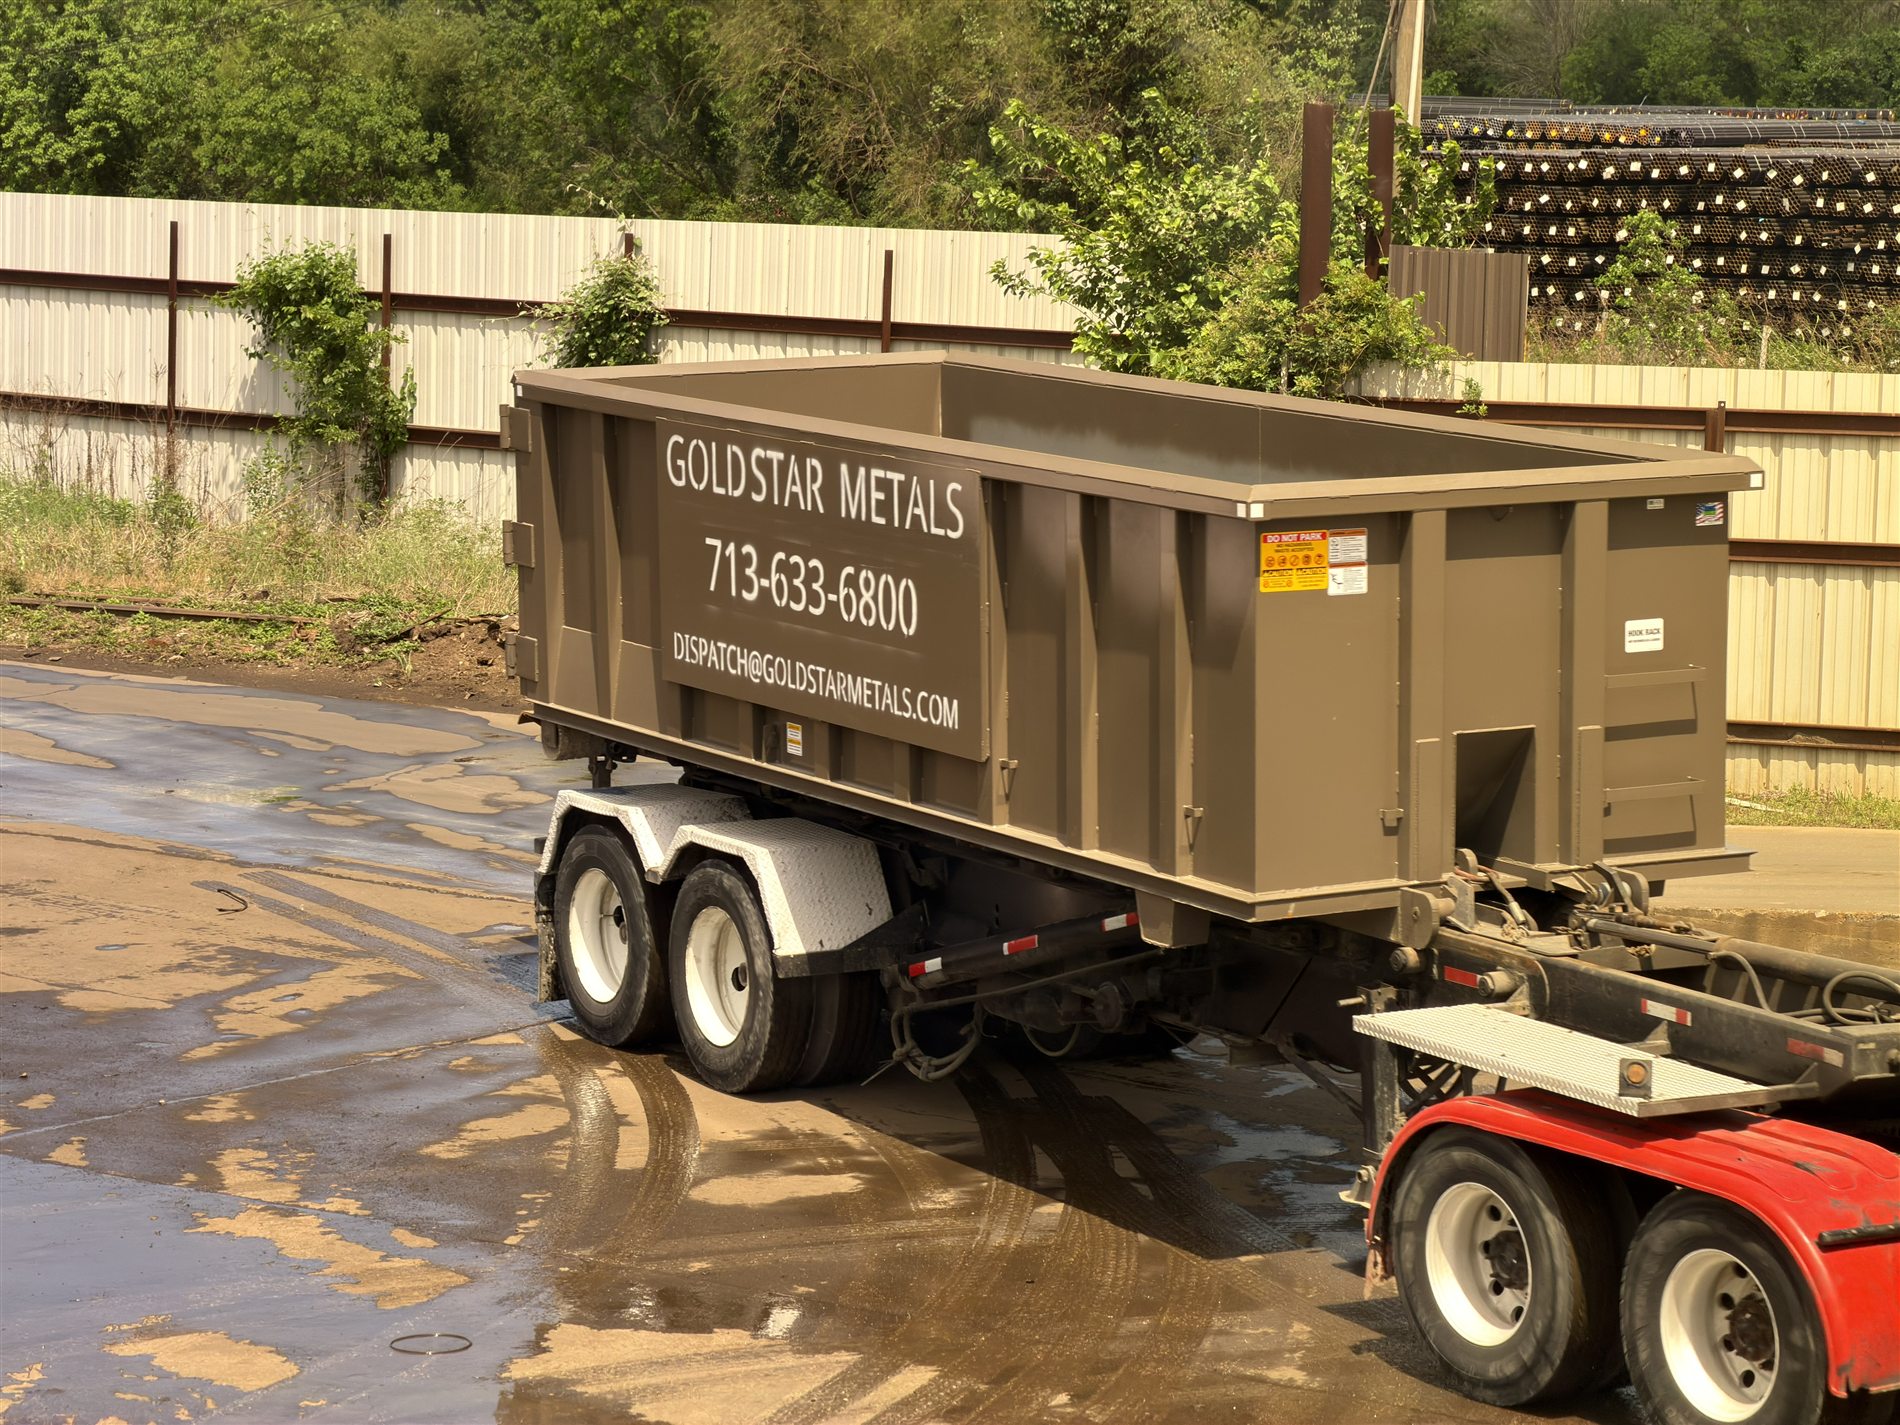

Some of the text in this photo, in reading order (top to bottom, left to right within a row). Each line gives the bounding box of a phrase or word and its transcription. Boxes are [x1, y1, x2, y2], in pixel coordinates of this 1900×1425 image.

[840, 463, 964, 539] METALS
[1266, 532, 1322, 543] DO NOT PARK
[705, 537, 918, 636] 713-633-6800
[673, 632, 959, 730] DISPATCH@GOLDSTARMETALS.COM
